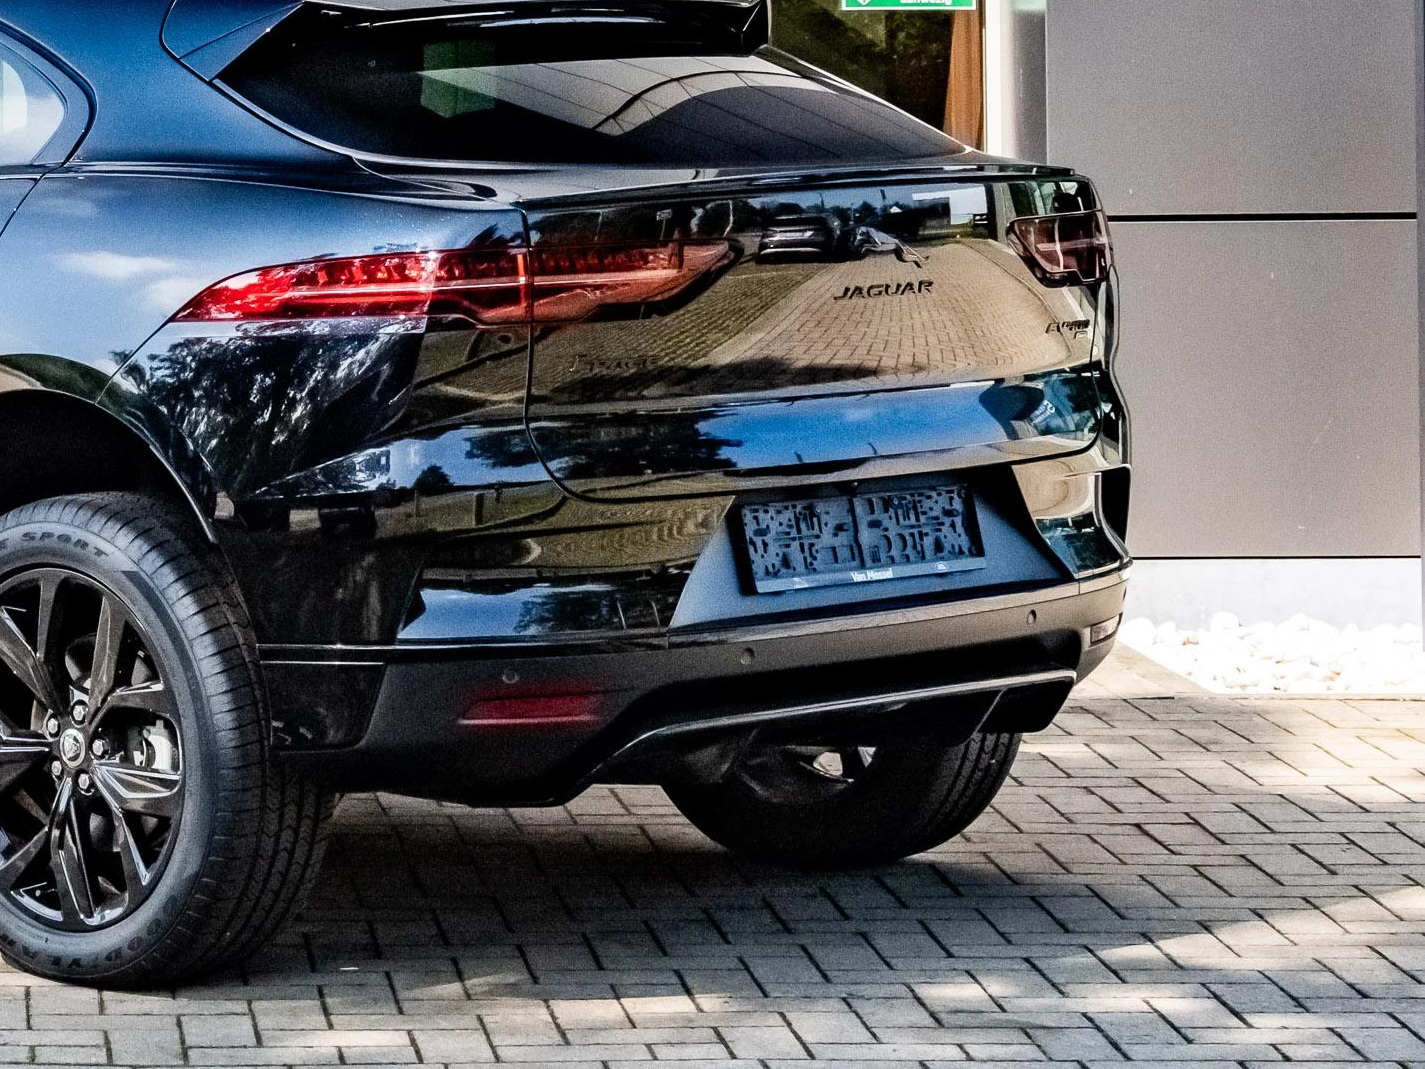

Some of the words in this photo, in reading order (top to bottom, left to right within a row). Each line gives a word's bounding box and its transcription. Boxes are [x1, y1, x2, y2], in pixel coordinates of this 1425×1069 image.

[833, 280, 934, 300] JAGUAR
[22, 531, 109, 558] SPORT
[850, 571, 866, 582] Van
[867, 567, 894, 580] Mossel
